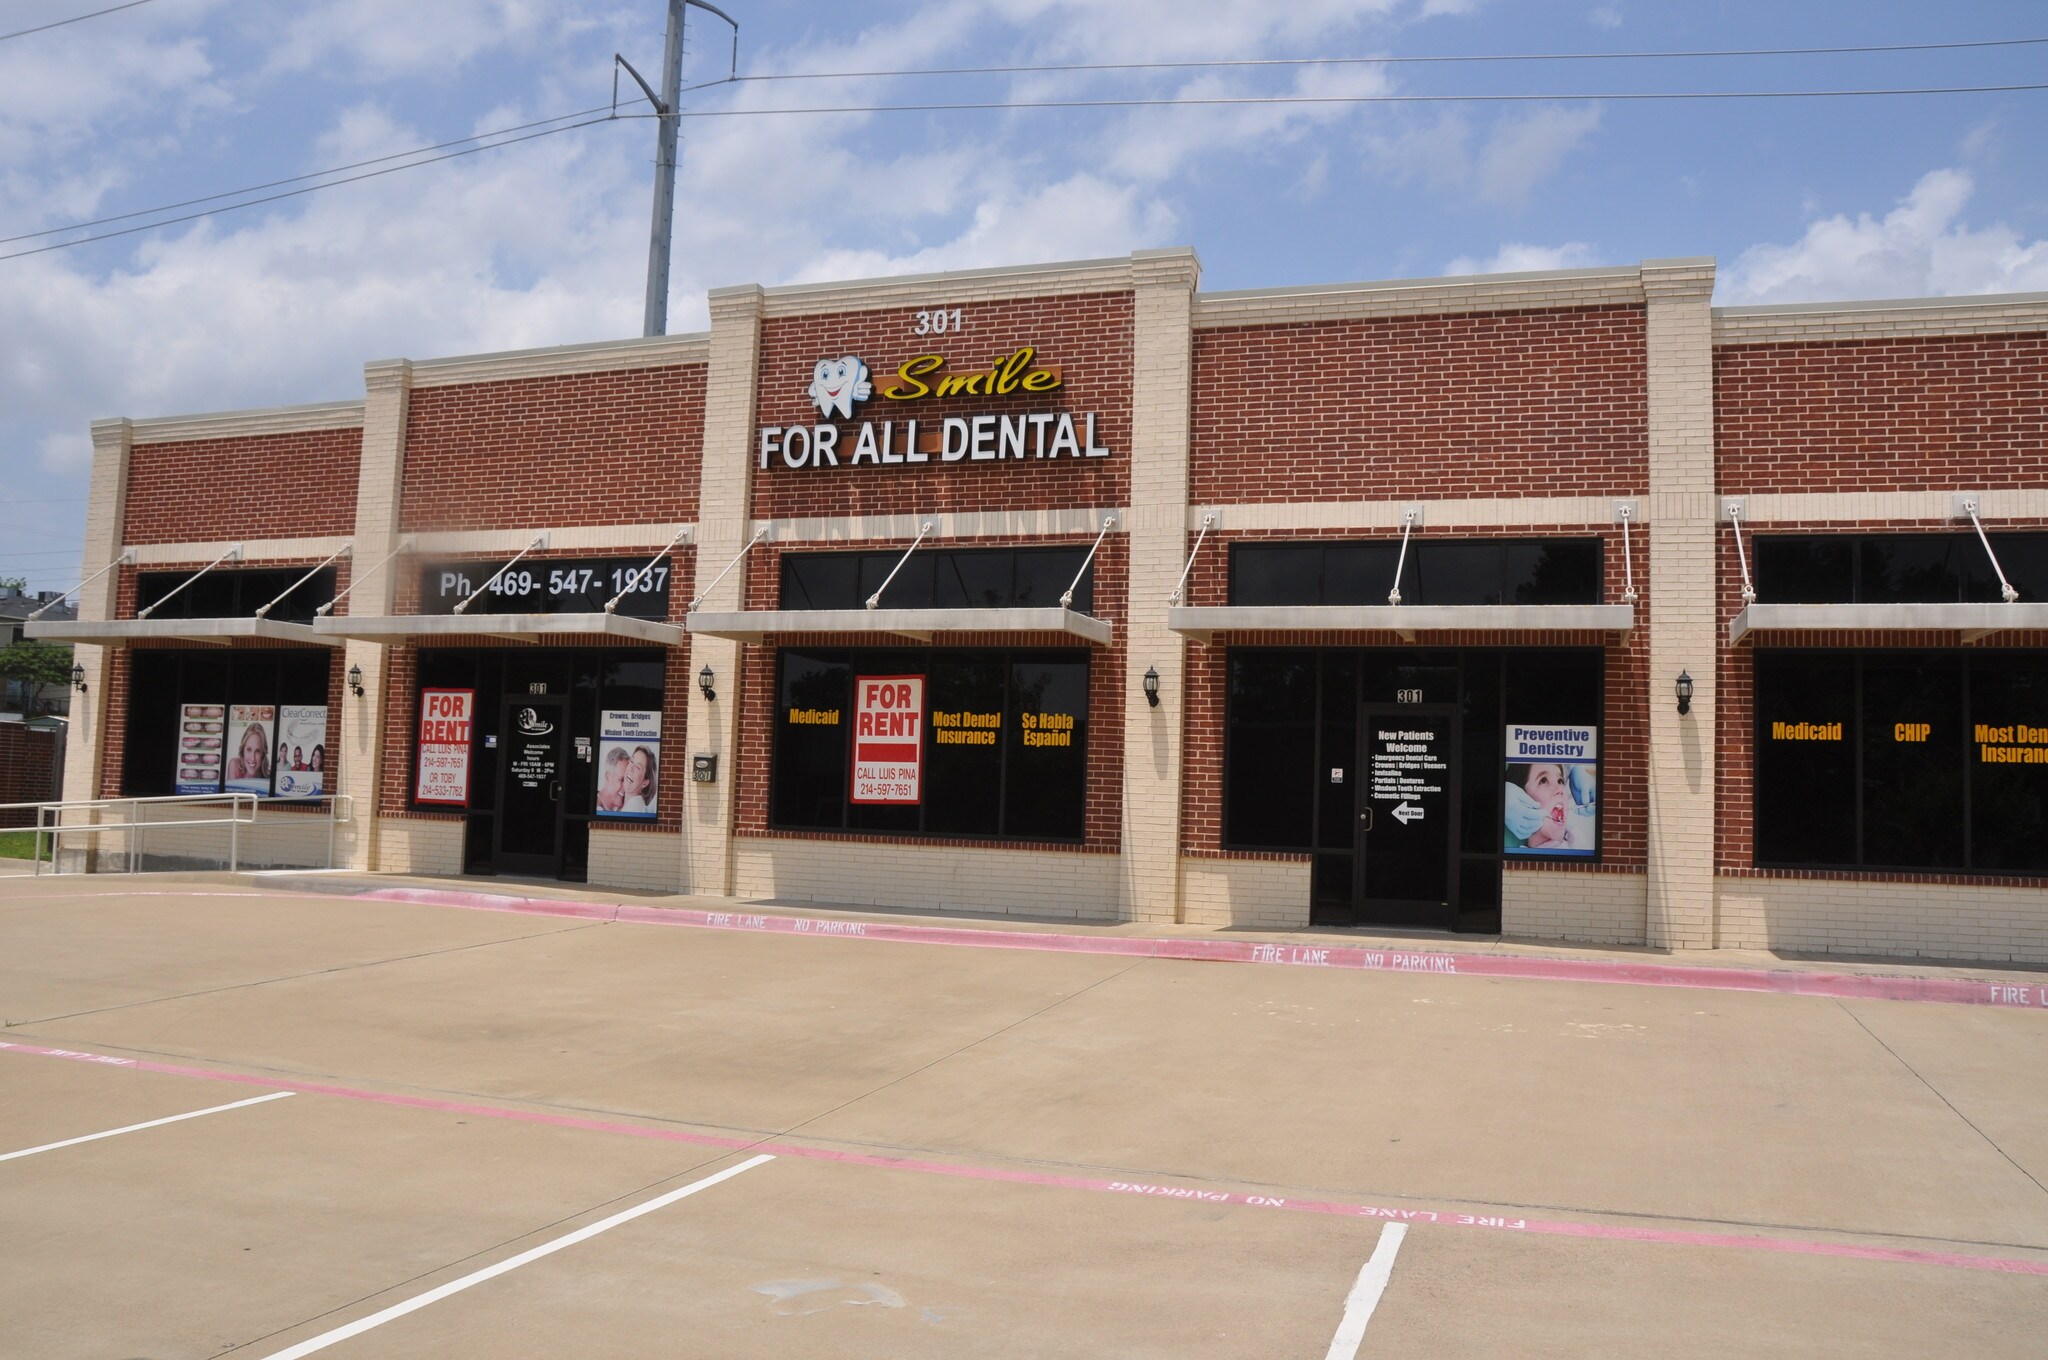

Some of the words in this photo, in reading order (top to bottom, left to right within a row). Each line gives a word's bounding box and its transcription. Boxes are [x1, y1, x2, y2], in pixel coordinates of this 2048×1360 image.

[915, 308, 962, 335] 301
[883, 347, 1062, 399] Smile
[761, 424, 839, 469] FOR
[851, 419, 929, 465] ALL
[942, 412, 1110, 461] DENTAL
[549, 569, 602, 594] 547-
[611, 567, 668, 593] 1937
[530, 683, 546, 694] 301
[866, 684, 911, 709] FOR
[1398, 689, 1422, 703] 301
[282, 708, 326, 718] ClearCorrect
[429, 696, 464, 717] FOR
[631, 713, 651, 721] Bridges
[789, 708, 839, 725] Medicaid
[859, 712, 919, 736] RENT
[933, 711, 961, 727] Most
[963, 711, 1001, 728] Dental
[1022, 712, 1037, 729] Se
[1039, 713, 1074, 729] Habla
[423, 720, 468, 741] RENT
[937, 728, 996, 745] Insurance
[1024, 729, 1071, 747] Español
[1379, 731, 1397, 740] New
[1398, 731, 1434, 741] Patients
[1514, 728, 1589, 741] Preventive
[1772, 722, 1842, 740] Medicaid
[1895, 723, 1931, 742] CHIP
[1975, 724, 2014, 743] Most
[422, 744, 437, 754] CALL
[438, 744, 451, 754] LUIS
[454, 745, 467, 755] PINA
[1386, 743, 1428, 753] Welcome
[1519, 742, 1584, 757] Dentistry
[857, 768, 876, 779] CALL
[879, 768, 895, 780] LUIS
[899, 768, 916, 780] PINA
[1398, 762, 1420, 770] Bridges
[692, 770, 711, 781] 301
[861, 783, 911, 796] 214-597-7651
[1399, 807, 1410, 816] Next
[1411, 807, 1423, 817] Door
[706, 913, 732, 927] FIRE
[737, 915, 768, 929] LANE
[794, 919, 810, 932] NO
[816, 920, 866, 935] PARKING
[1252, 944, 1285, 962] FIRE
[1292, 949, 1330, 966] LANE
[1364, 953, 1384, 969] NO
[1392, 954, 1456, 973] PARKING
[1990, 986, 2030, 1004] FIRE
[1108, 1181, 1229, 1201] PARKING
[1245, 1195, 1285, 1207] NO
[1360, 1206, 1438, 1222] LANE
[1457, 1214, 1526, 1229] FIRE
